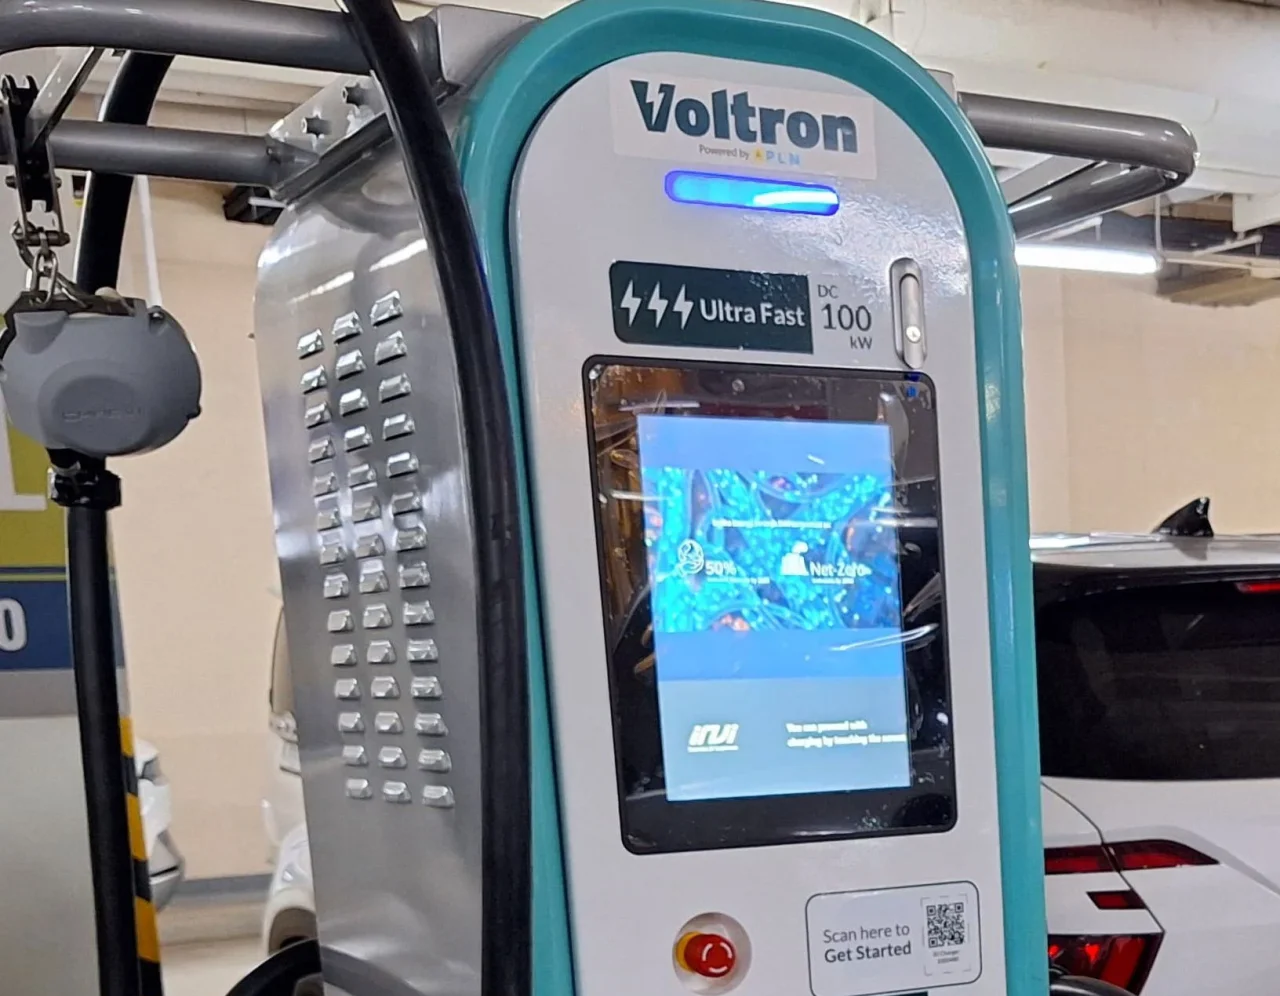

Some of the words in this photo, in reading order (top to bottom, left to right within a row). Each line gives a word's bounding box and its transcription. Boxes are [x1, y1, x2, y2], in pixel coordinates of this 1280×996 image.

[630, 79, 858, 153] Voltron
[699, 144, 737, 157] Powered
[739, 147, 750, 161] by
[818, 284, 839, 299] DC
[700, 298, 757, 325] Ultra
[760, 304, 805, 328] Fast
[822, 304, 872, 332] 100
[850, 335, 873, 351] kW
[705, 559, 737, 576] 50%
[823, 926, 858, 945] Scan
[860, 924, 891, 940] here
[895, 923, 910, 937] to
[824, 947, 852, 963] Get
[856, 940, 912, 960] Started
